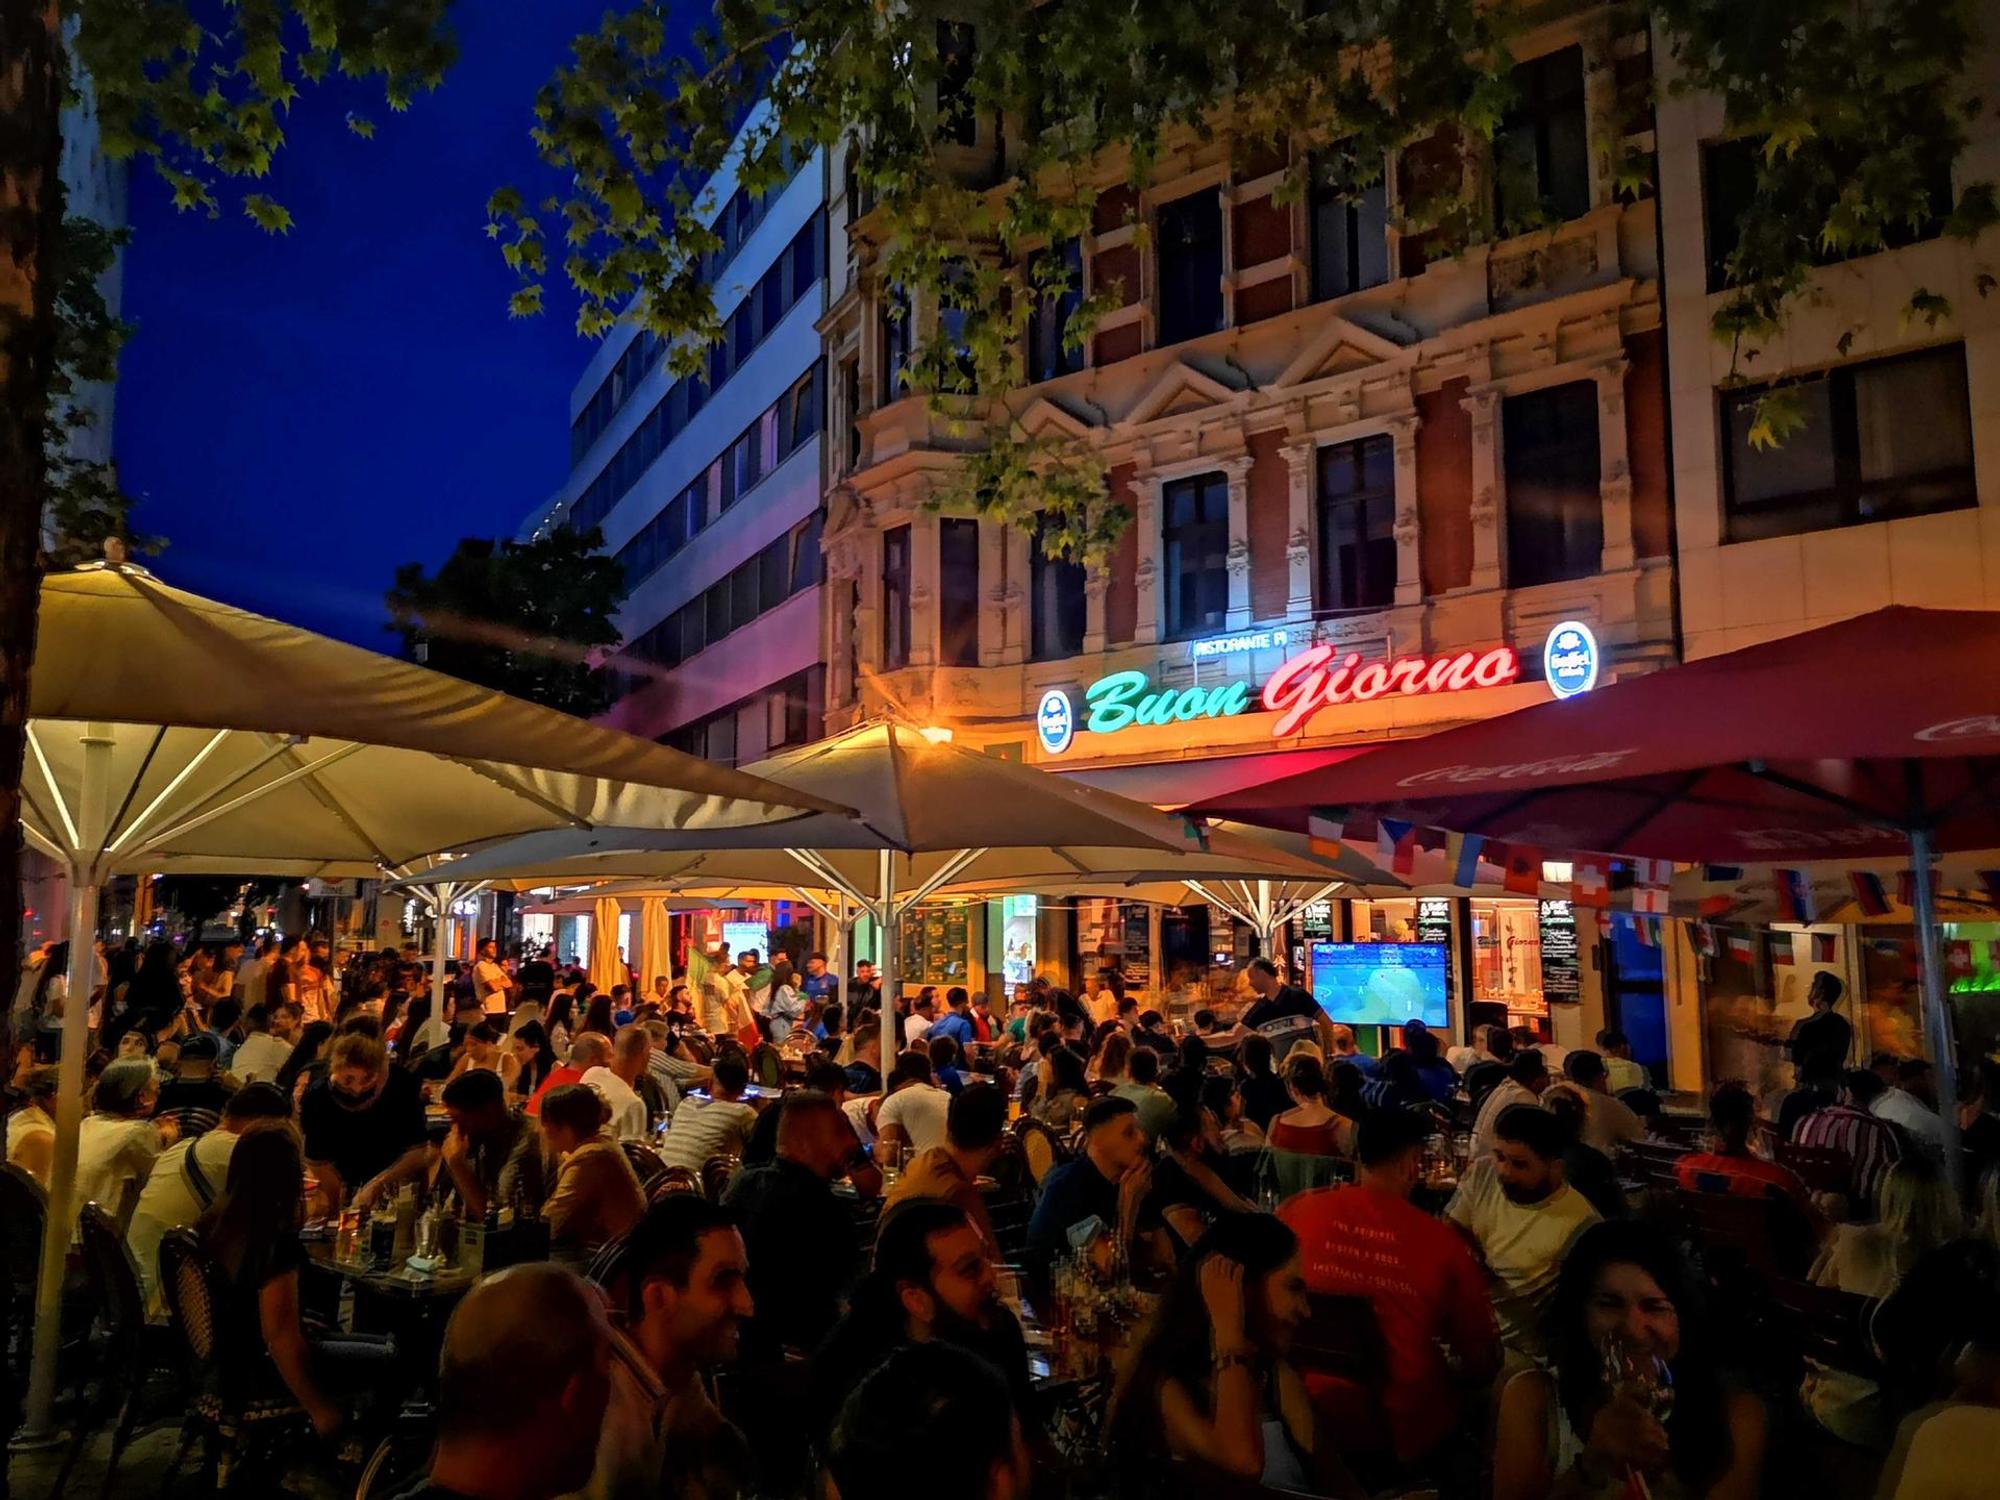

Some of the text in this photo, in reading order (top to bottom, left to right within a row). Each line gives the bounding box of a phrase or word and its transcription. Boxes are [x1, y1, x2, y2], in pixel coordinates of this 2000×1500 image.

[1194, 633, 1270, 656] RISTORANTE
[1086, 643, 1518, 737] Buon Giorno
